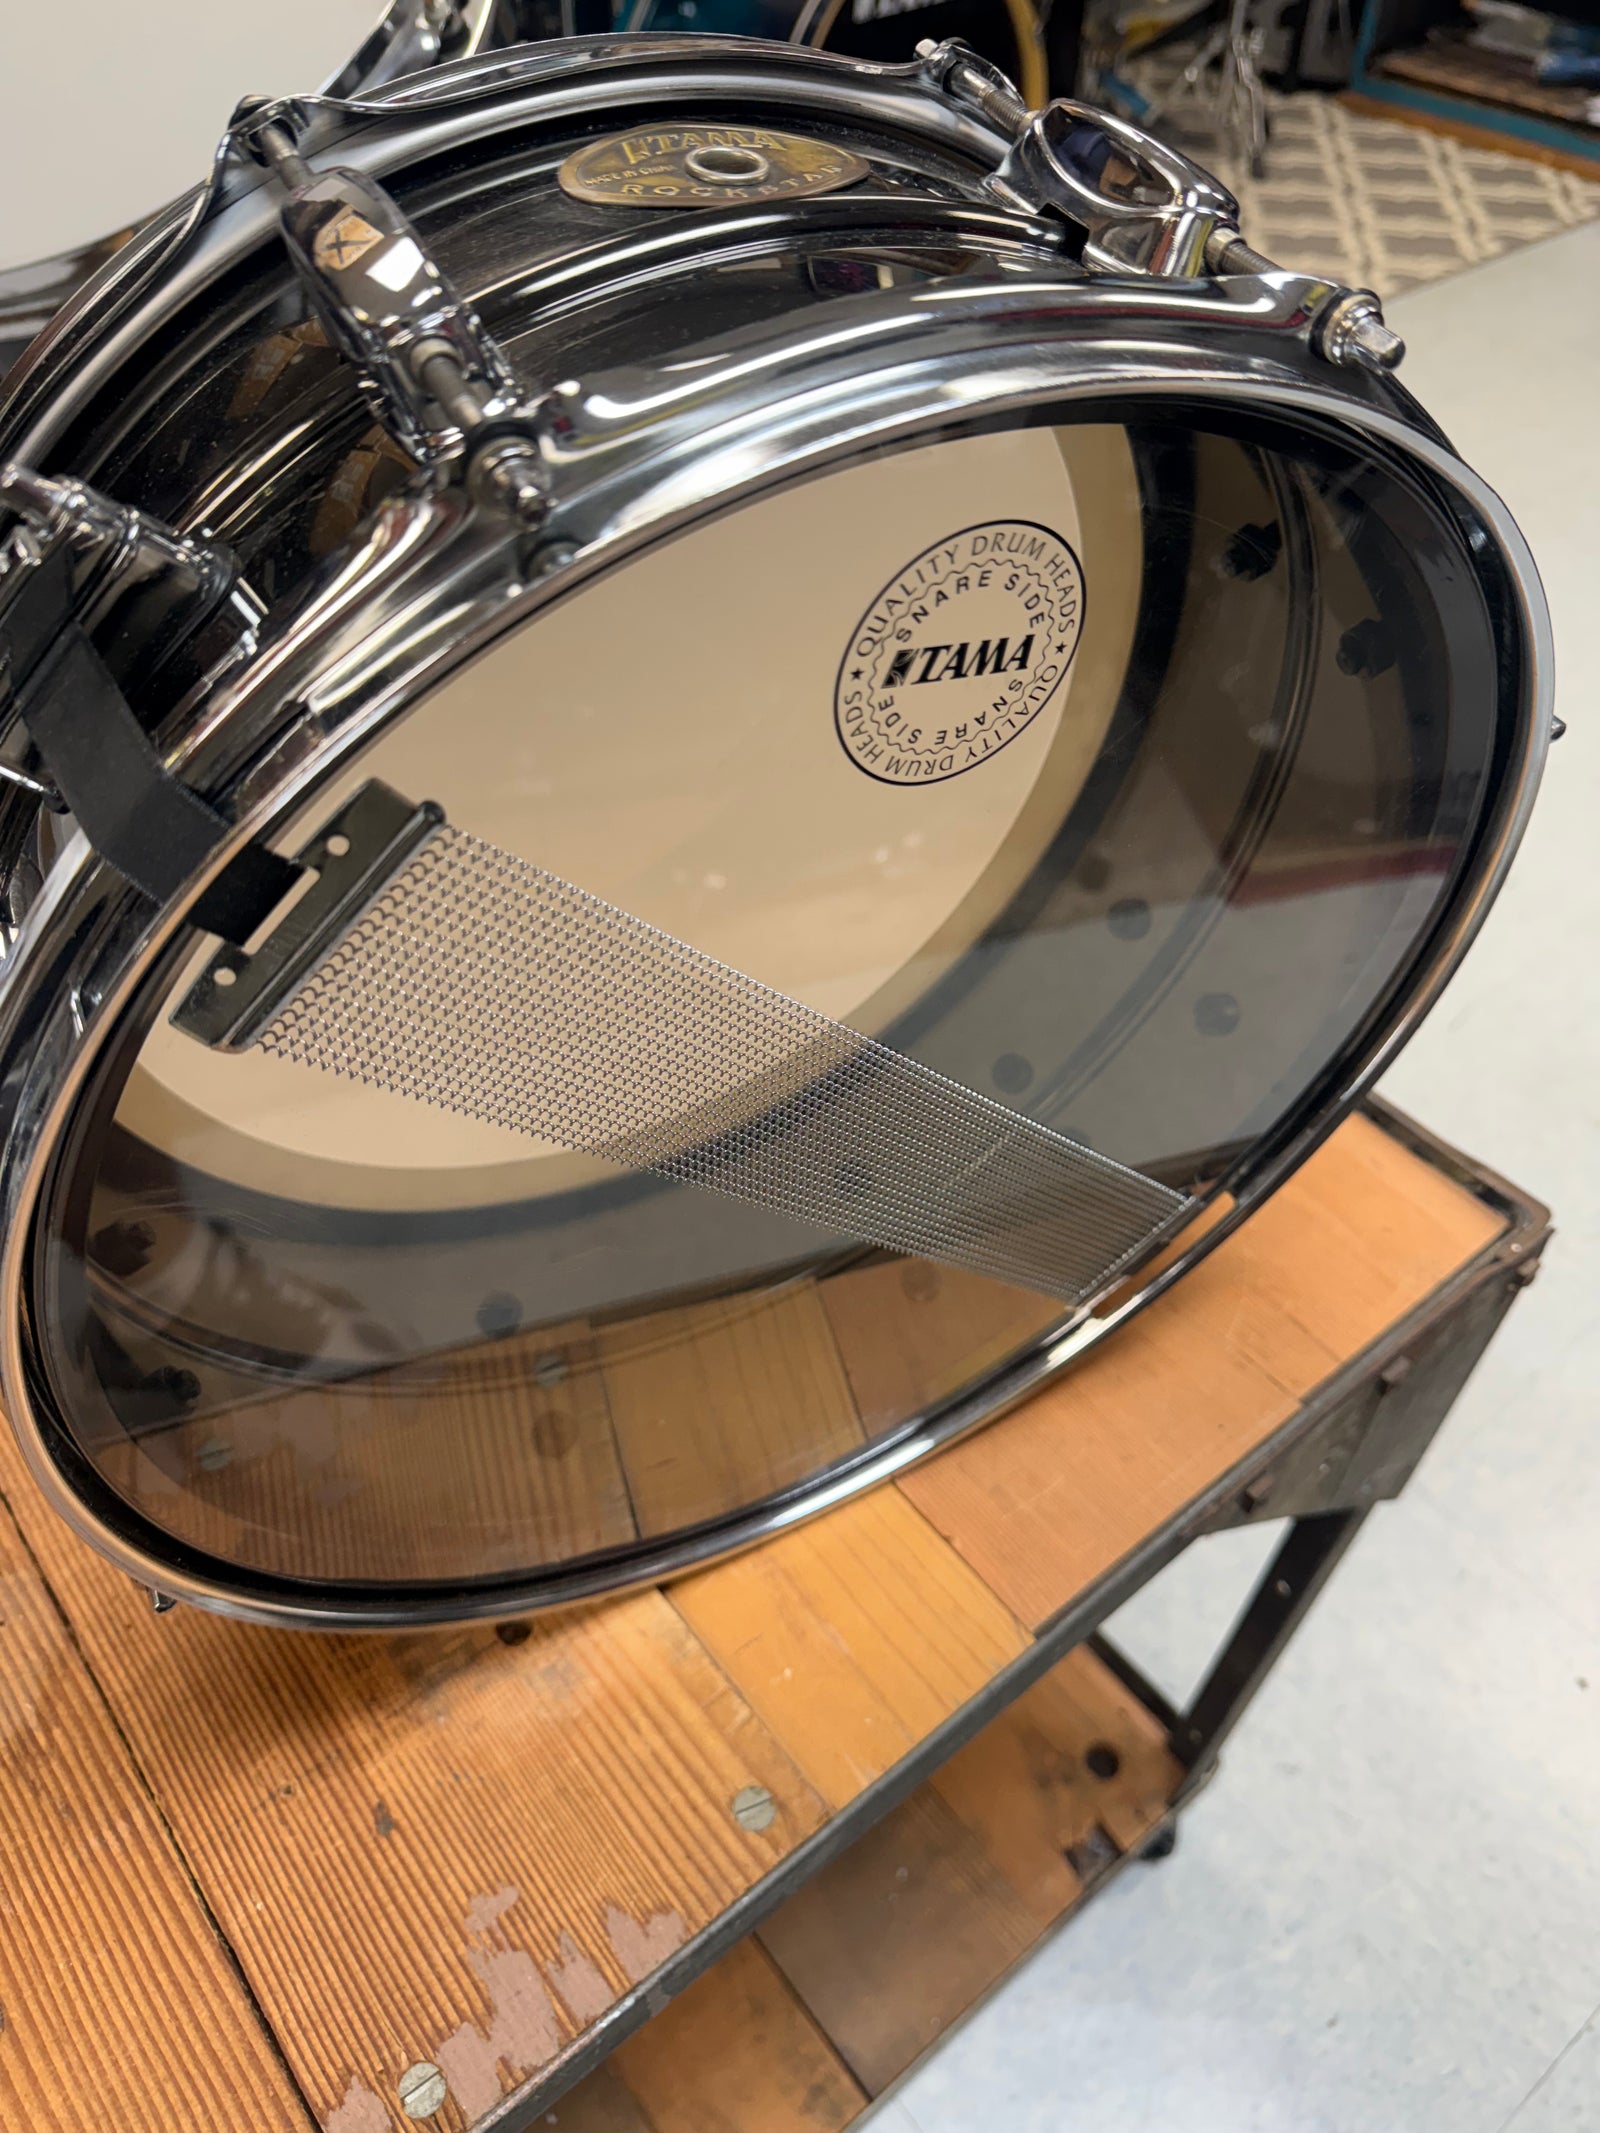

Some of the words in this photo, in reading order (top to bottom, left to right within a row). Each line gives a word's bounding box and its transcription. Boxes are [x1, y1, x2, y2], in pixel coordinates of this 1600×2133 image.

[651, 131, 788, 157] TAMA
[620, 164, 844, 198] ROCKSTAR
[856, 544, 959, 657] QUALITY
[971, 532, 1047, 561] DRUM
[1043, 553, 1077, 633] HEADS
[896, 570, 993, 643] SNARE
[1004, 573, 1045, 628] SIDE
[910, 634, 1036, 685] TAMA
[844, 690, 885, 764] HEADS
[878, 695, 922, 744] SIDE
[934, 679, 1023, 745] SNARE
[965, 664, 1058, 763] QUALITY
[884, 754, 954, 777] DRUM
